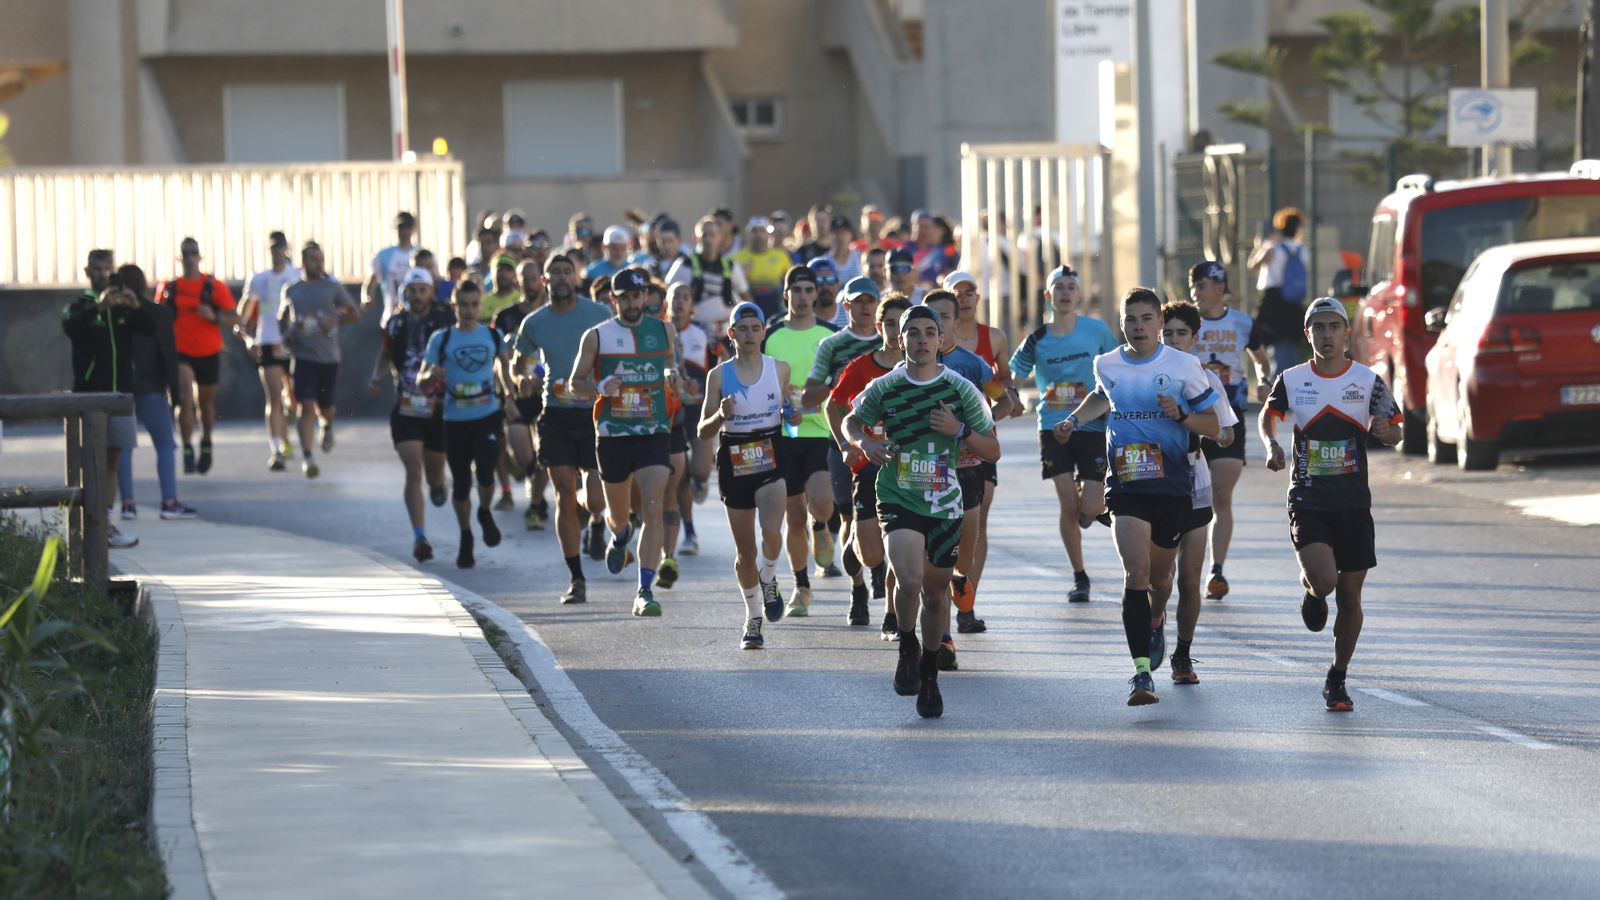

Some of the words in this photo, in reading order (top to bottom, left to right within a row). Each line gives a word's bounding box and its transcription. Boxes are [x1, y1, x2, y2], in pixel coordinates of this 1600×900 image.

[622, 393, 640, 404] 378
[741, 446, 763, 460] 330
[1124, 449, 1147, 464] 521
[1321, 446, 1346, 459] 604
[911, 459, 936, 474] 606
[1146, 463, 1161, 472] 2023
